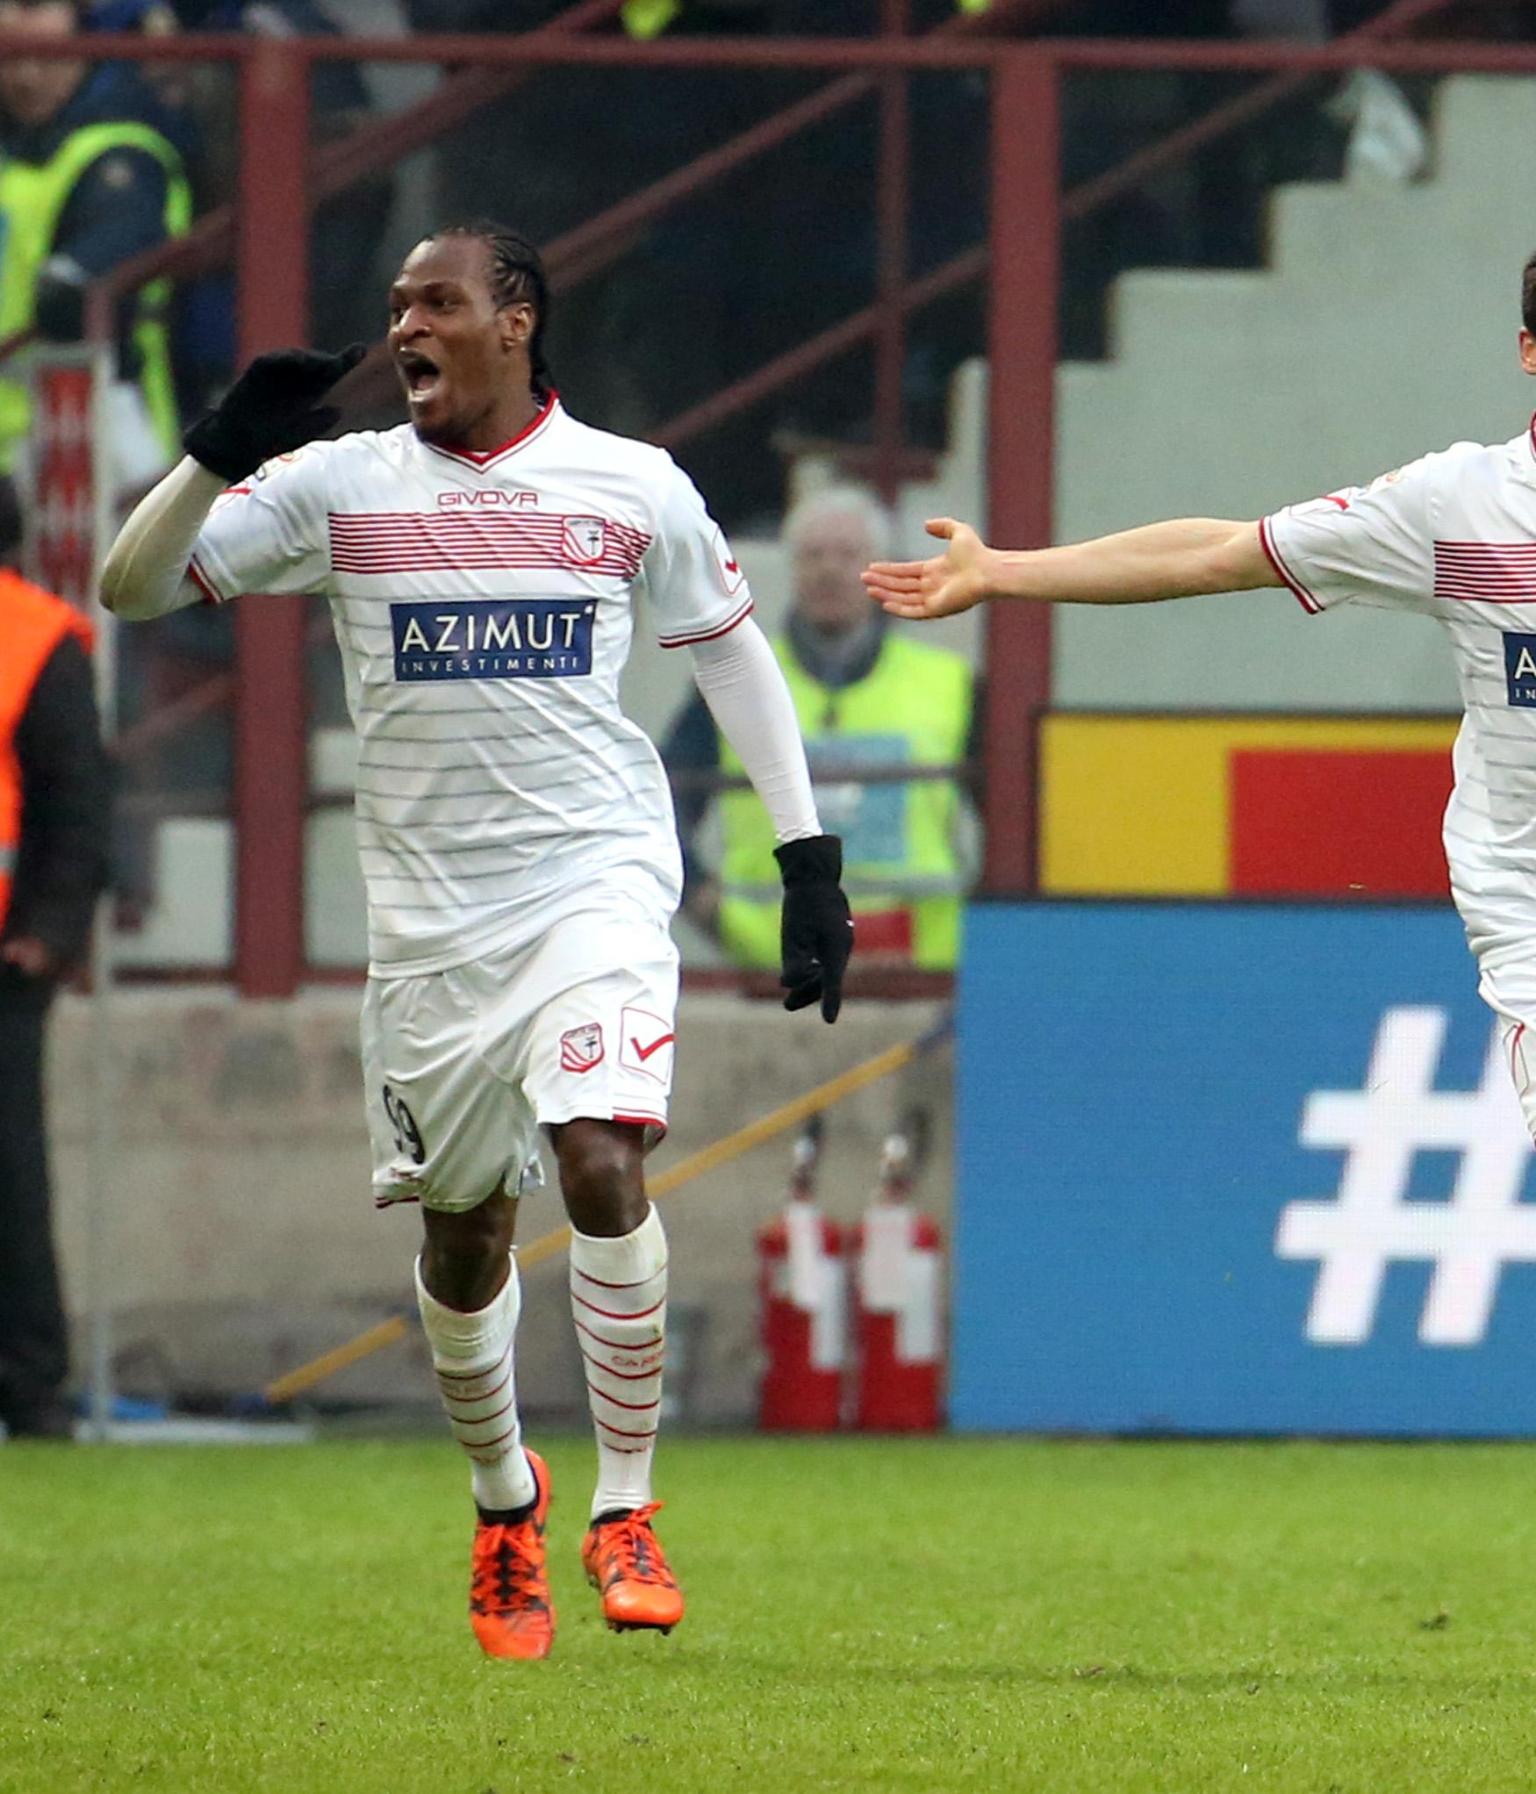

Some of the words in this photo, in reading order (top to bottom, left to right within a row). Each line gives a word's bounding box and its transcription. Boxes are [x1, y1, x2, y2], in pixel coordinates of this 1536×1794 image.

[437, 490, 538, 507] GIVOVA
[401, 612, 579, 655] AZIMUT
[402, 656, 579, 674] INVESTIMENTI
